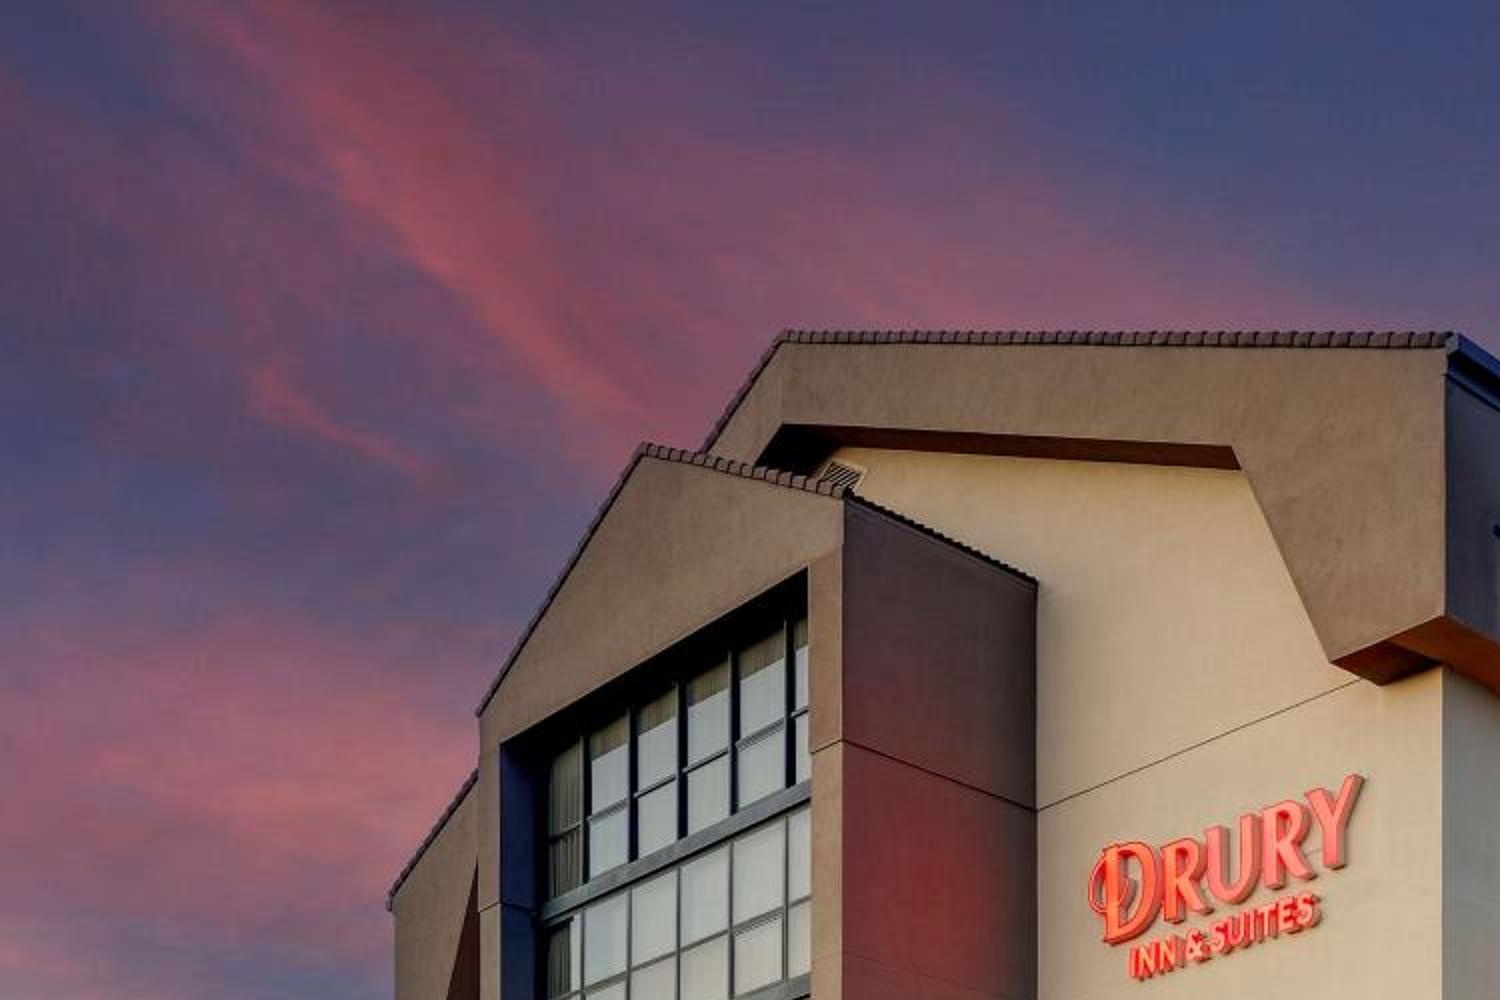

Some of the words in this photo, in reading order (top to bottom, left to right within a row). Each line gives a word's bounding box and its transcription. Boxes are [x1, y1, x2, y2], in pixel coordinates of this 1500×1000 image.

[1088, 773, 1364, 945] DRURY
[1128, 934, 1186, 980] INN
[1184, 929, 1212, 963] &
[1209, 891, 1321, 955] SUITES
